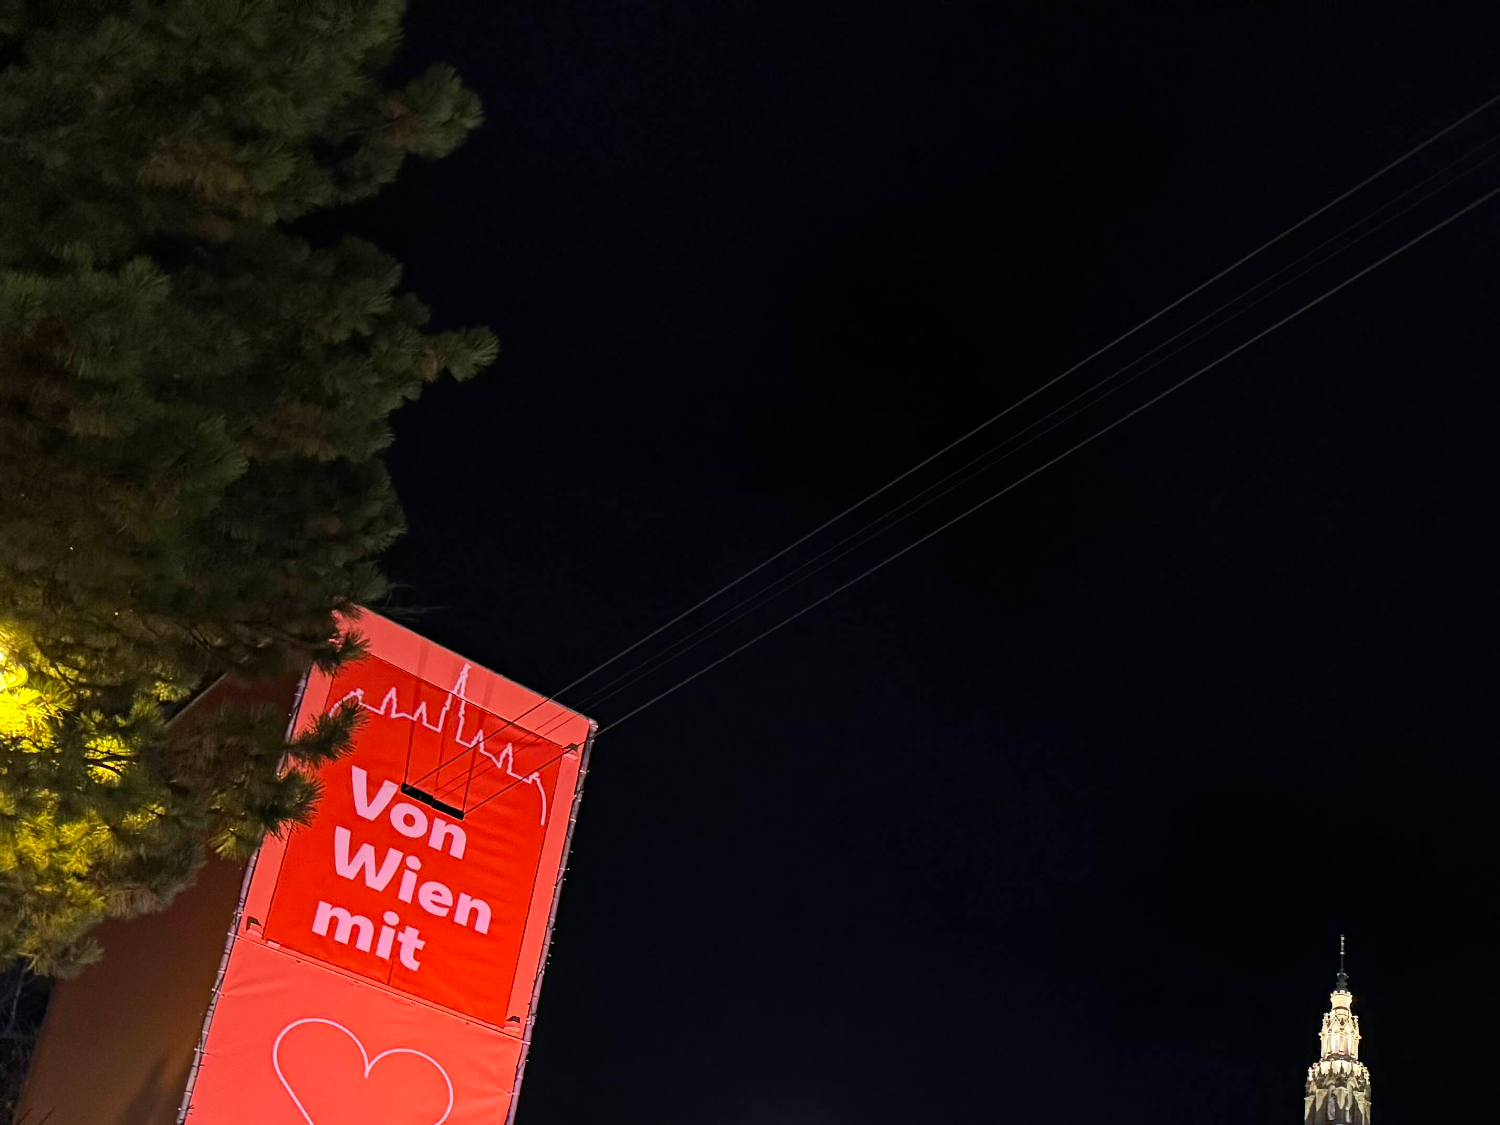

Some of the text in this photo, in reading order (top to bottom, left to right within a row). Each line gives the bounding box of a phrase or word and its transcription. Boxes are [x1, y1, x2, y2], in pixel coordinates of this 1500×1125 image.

[351, 765, 467, 859] Von
[334, 827, 492, 935] Wien
[312, 901, 425, 971] mit
